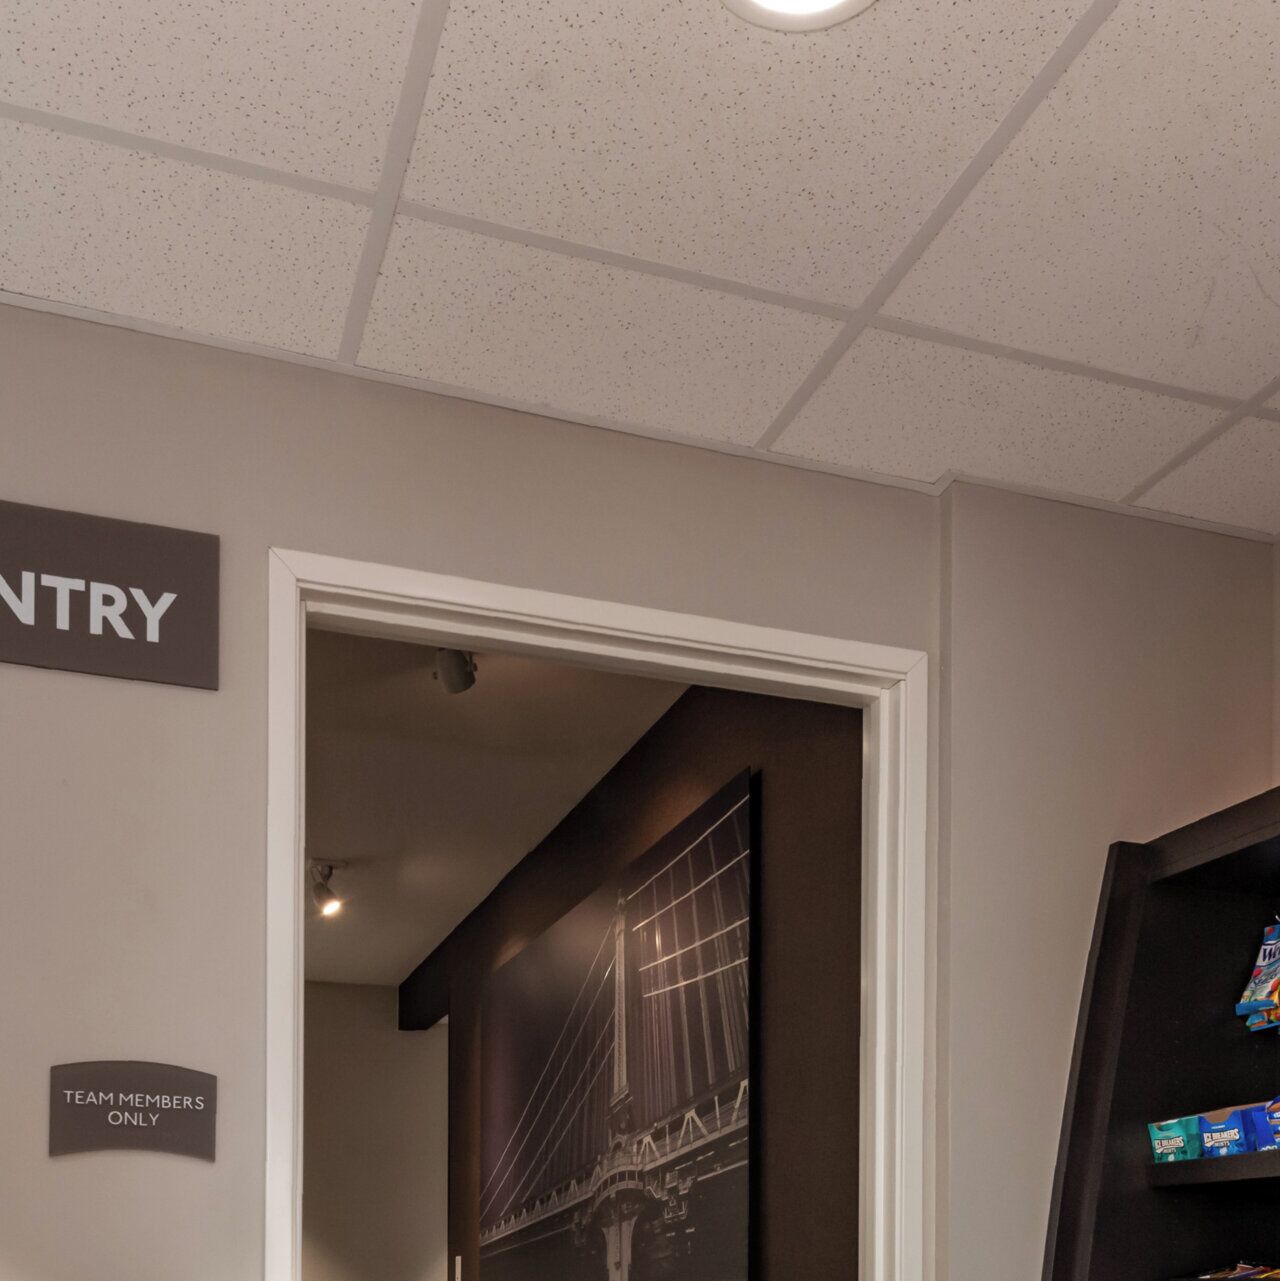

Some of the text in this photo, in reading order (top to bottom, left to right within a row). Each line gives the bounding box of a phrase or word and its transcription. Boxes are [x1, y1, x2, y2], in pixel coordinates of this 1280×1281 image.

[63, 1090, 205, 1110] TEAM MEMBERS
[108, 1110, 160, 1126] ONLY
